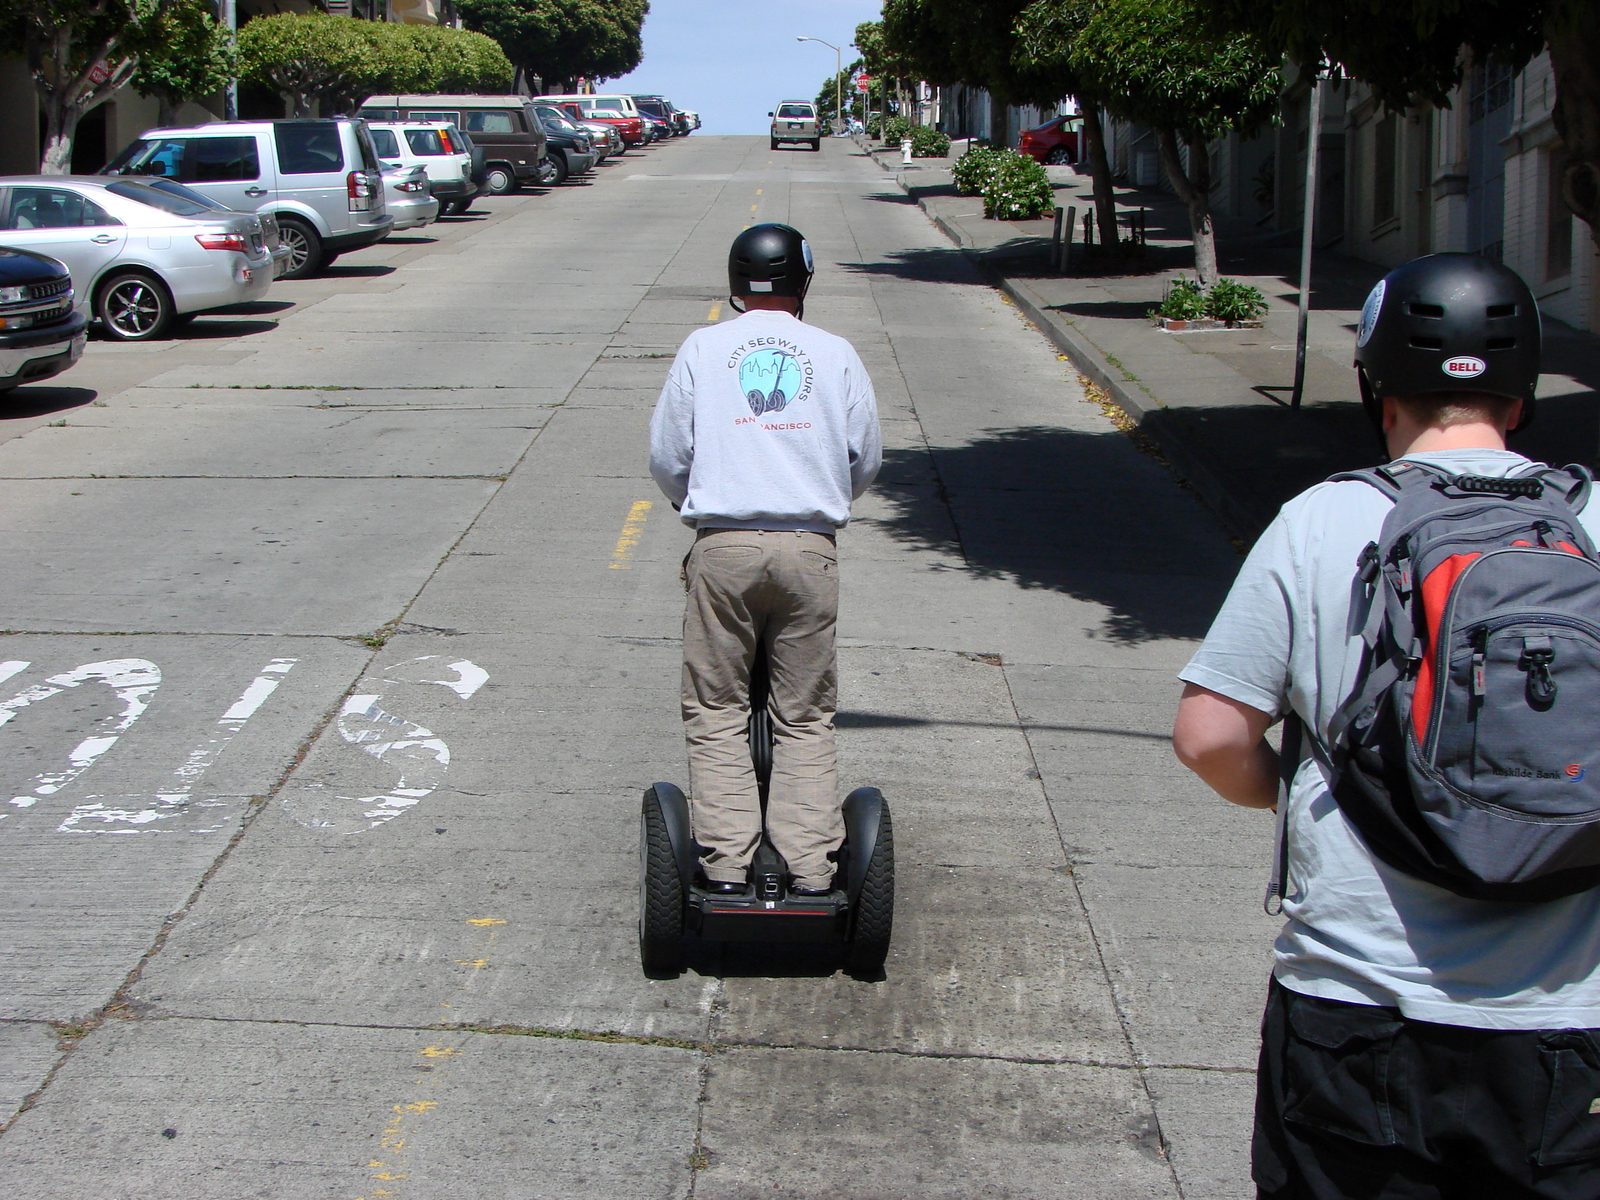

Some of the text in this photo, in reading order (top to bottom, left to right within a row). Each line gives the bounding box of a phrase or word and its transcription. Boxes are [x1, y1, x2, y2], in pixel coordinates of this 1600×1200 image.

[727, 337, 814, 401] CITY SEGWAY TOURS
[1449, 362, 1479, 372] BELL
[735, 416, 812, 431] SAN ANCISCO
